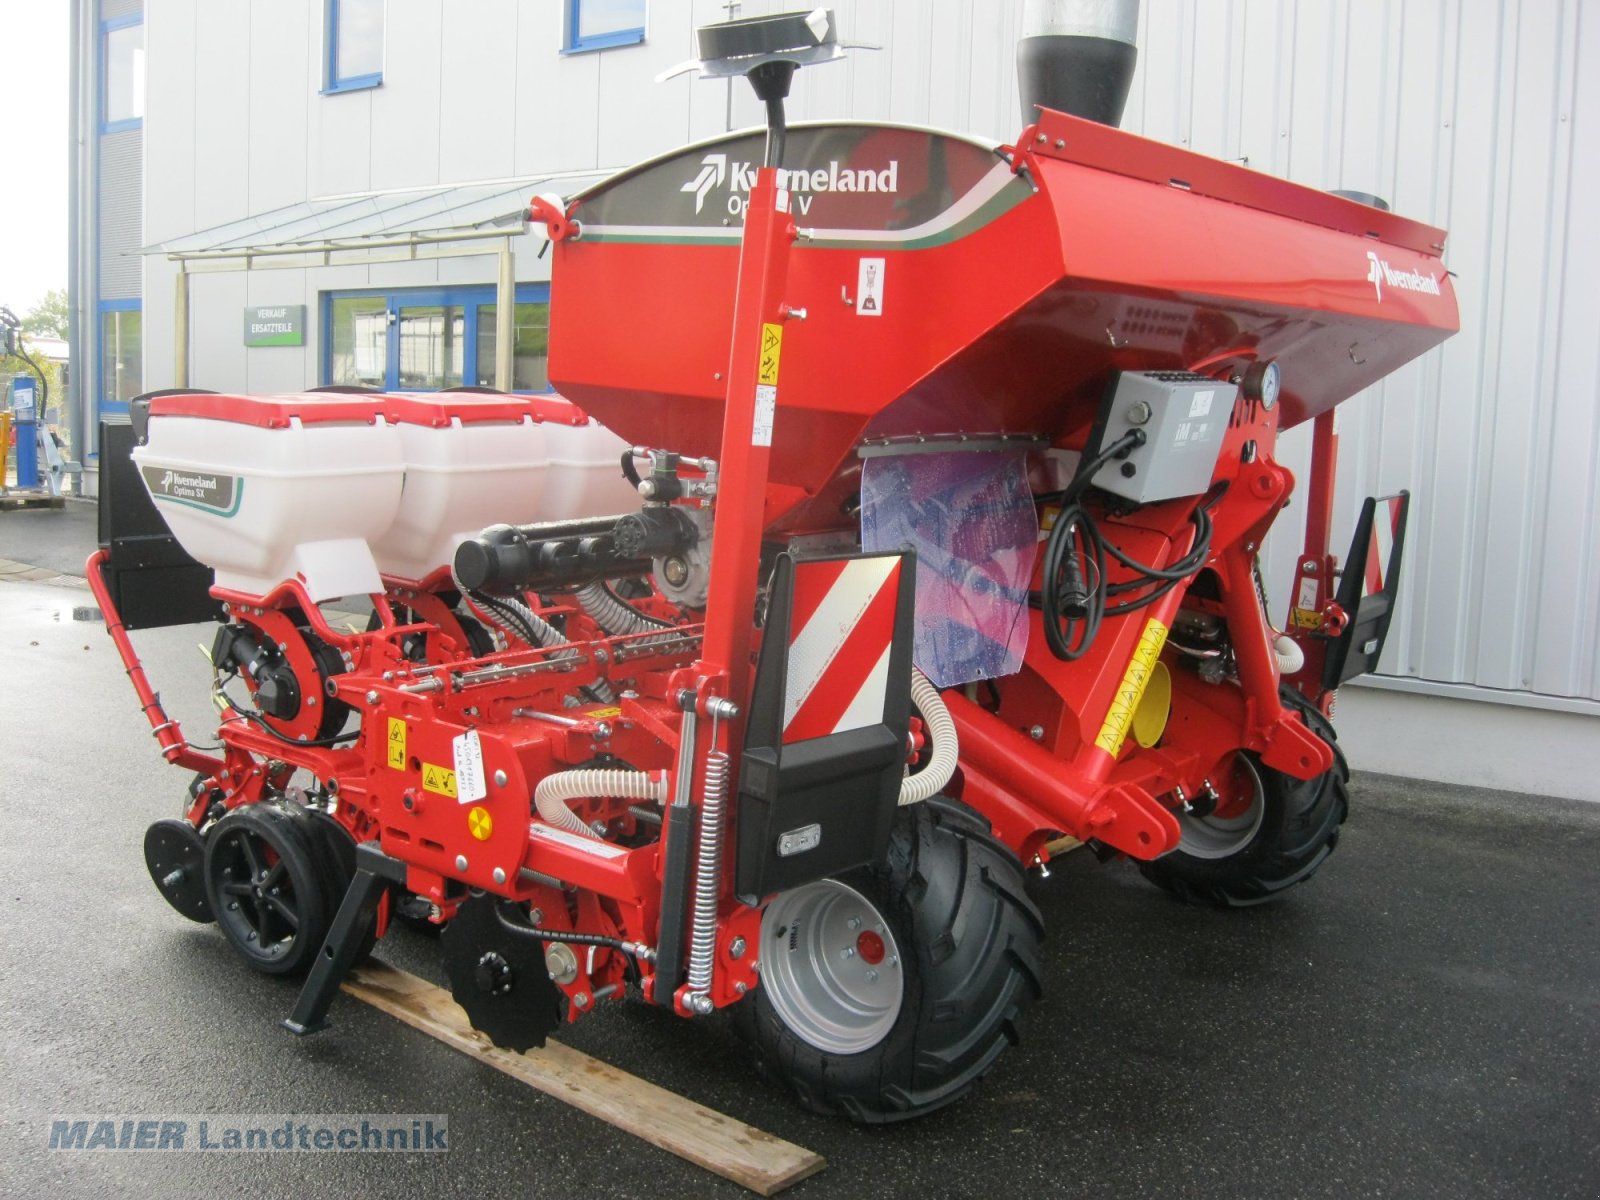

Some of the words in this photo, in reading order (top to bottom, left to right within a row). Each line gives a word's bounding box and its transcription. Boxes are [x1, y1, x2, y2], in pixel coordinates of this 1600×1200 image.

[730, 160, 898, 193] Kvrneland
[799, 195, 813, 216] V
[1380, 260, 1441, 296] Kverneland
[257, 308, 287, 319] VERKAUF
[251, 322, 292, 334] ERSATZTEILE
[173, 472, 217, 490] Kverneland
[173, 485, 196, 498] Optima
[196, 488, 206, 499] SX
